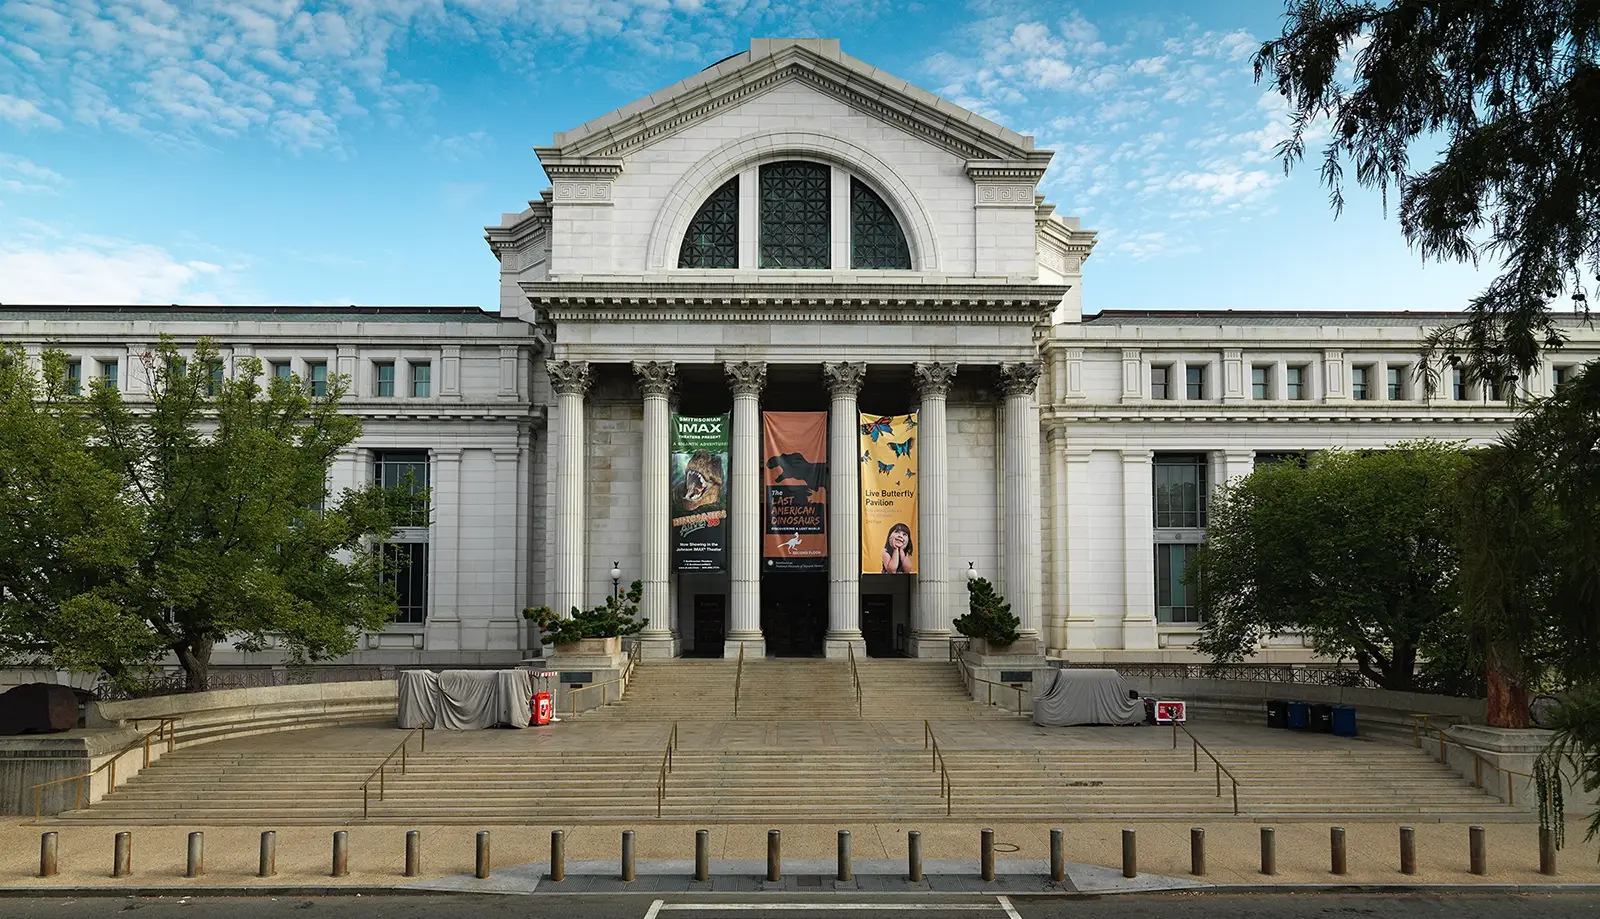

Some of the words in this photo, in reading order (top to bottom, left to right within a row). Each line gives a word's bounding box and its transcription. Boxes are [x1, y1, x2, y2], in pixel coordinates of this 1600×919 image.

[679, 424, 722, 432] IMAX
[881, 490, 914, 498] Butterfly
[772, 496, 794, 505] LAST
[866, 498, 894, 506] Pavilion
[771, 506, 816, 516] AMERICAN
[771, 516, 820, 526] DINOSAURS
